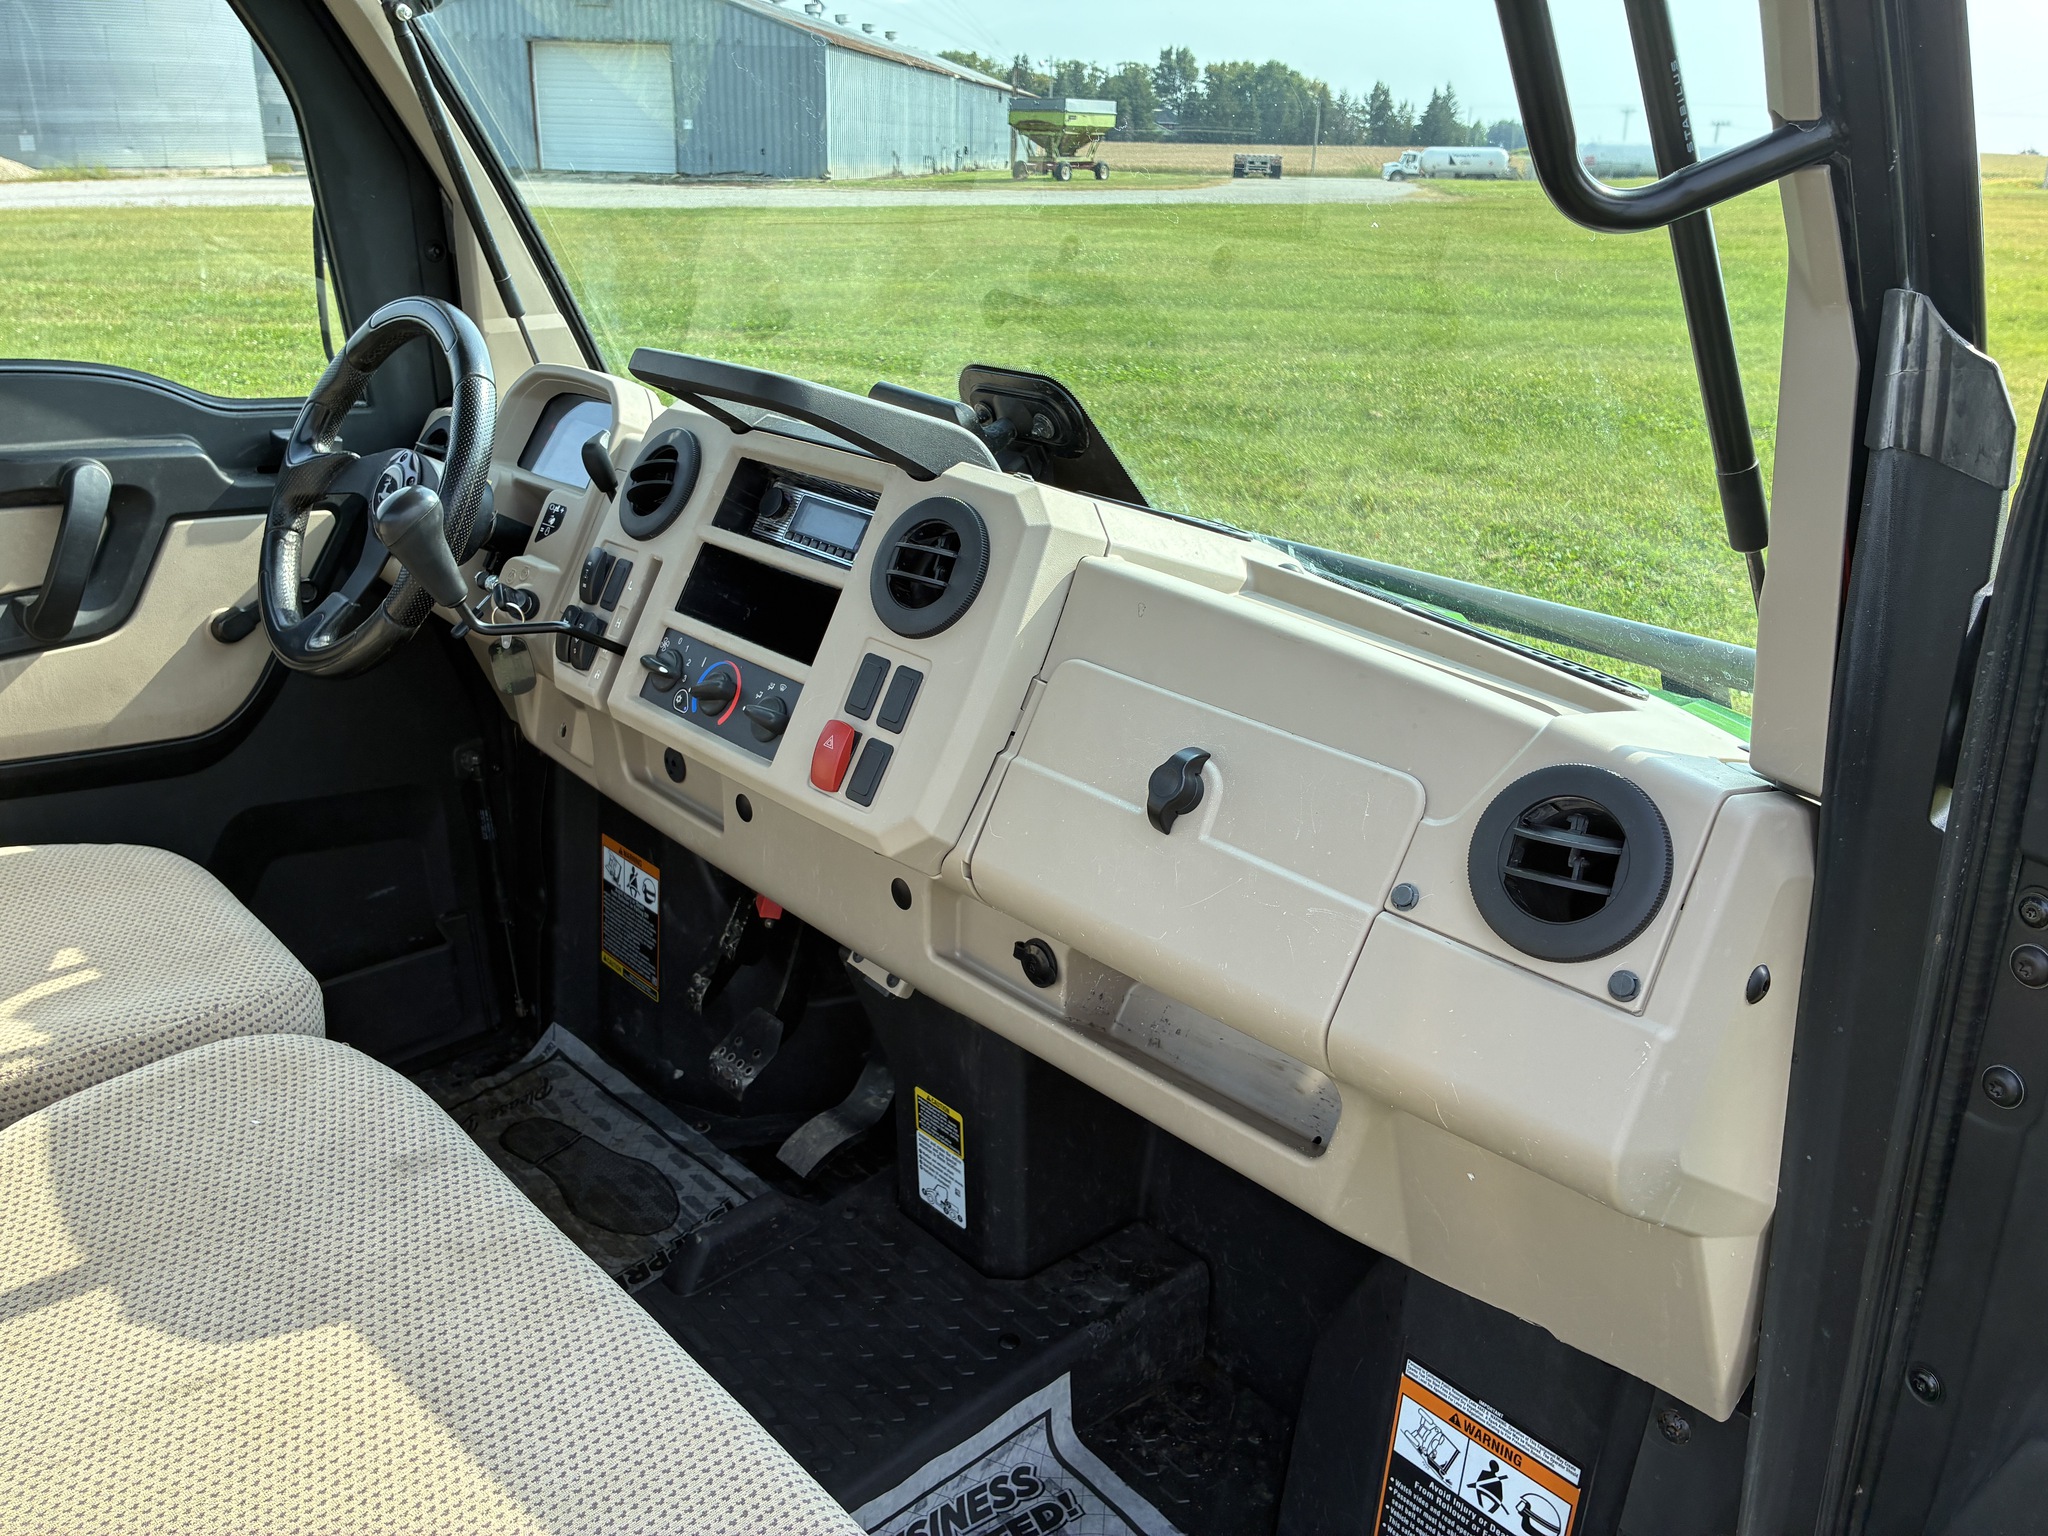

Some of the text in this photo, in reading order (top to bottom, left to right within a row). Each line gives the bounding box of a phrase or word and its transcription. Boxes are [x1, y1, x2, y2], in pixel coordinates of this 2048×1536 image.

[1670, 60, 1694, 153] STABILUS
[681, 674, 688, 683] 3
[686, 658, 692, 667] 2
[1478, 1399, 1504, 1418] IMPORTANT
[1462, 1419, 1523, 1468] WARNING
[898, 1466, 1040, 1536] SINESS
[1388, 1515, 1400, 1529] This
[1391, 1497, 1404, 1512] seat
[1404, 1506, 1416, 1521] belt
[1416, 1516, 1424, 1527] on
[1424, 1521, 1436, 1535] and
[1392, 1487, 1422, 1515] Passenger
[1422, 1509, 1437, 1525] must
[1437, 1520, 1446, 1531] be
[1394, 1478, 1412, 1497] Watch
[1412, 1491, 1429, 1509] video
[1429, 1503, 1441, 1517] and
[1441, 1512, 1455, 1527] read
[1414, 1480, 1480, 1533] From Rollover or
[1428, 1480, 1508, 1536] Avoid Injury or Dea
